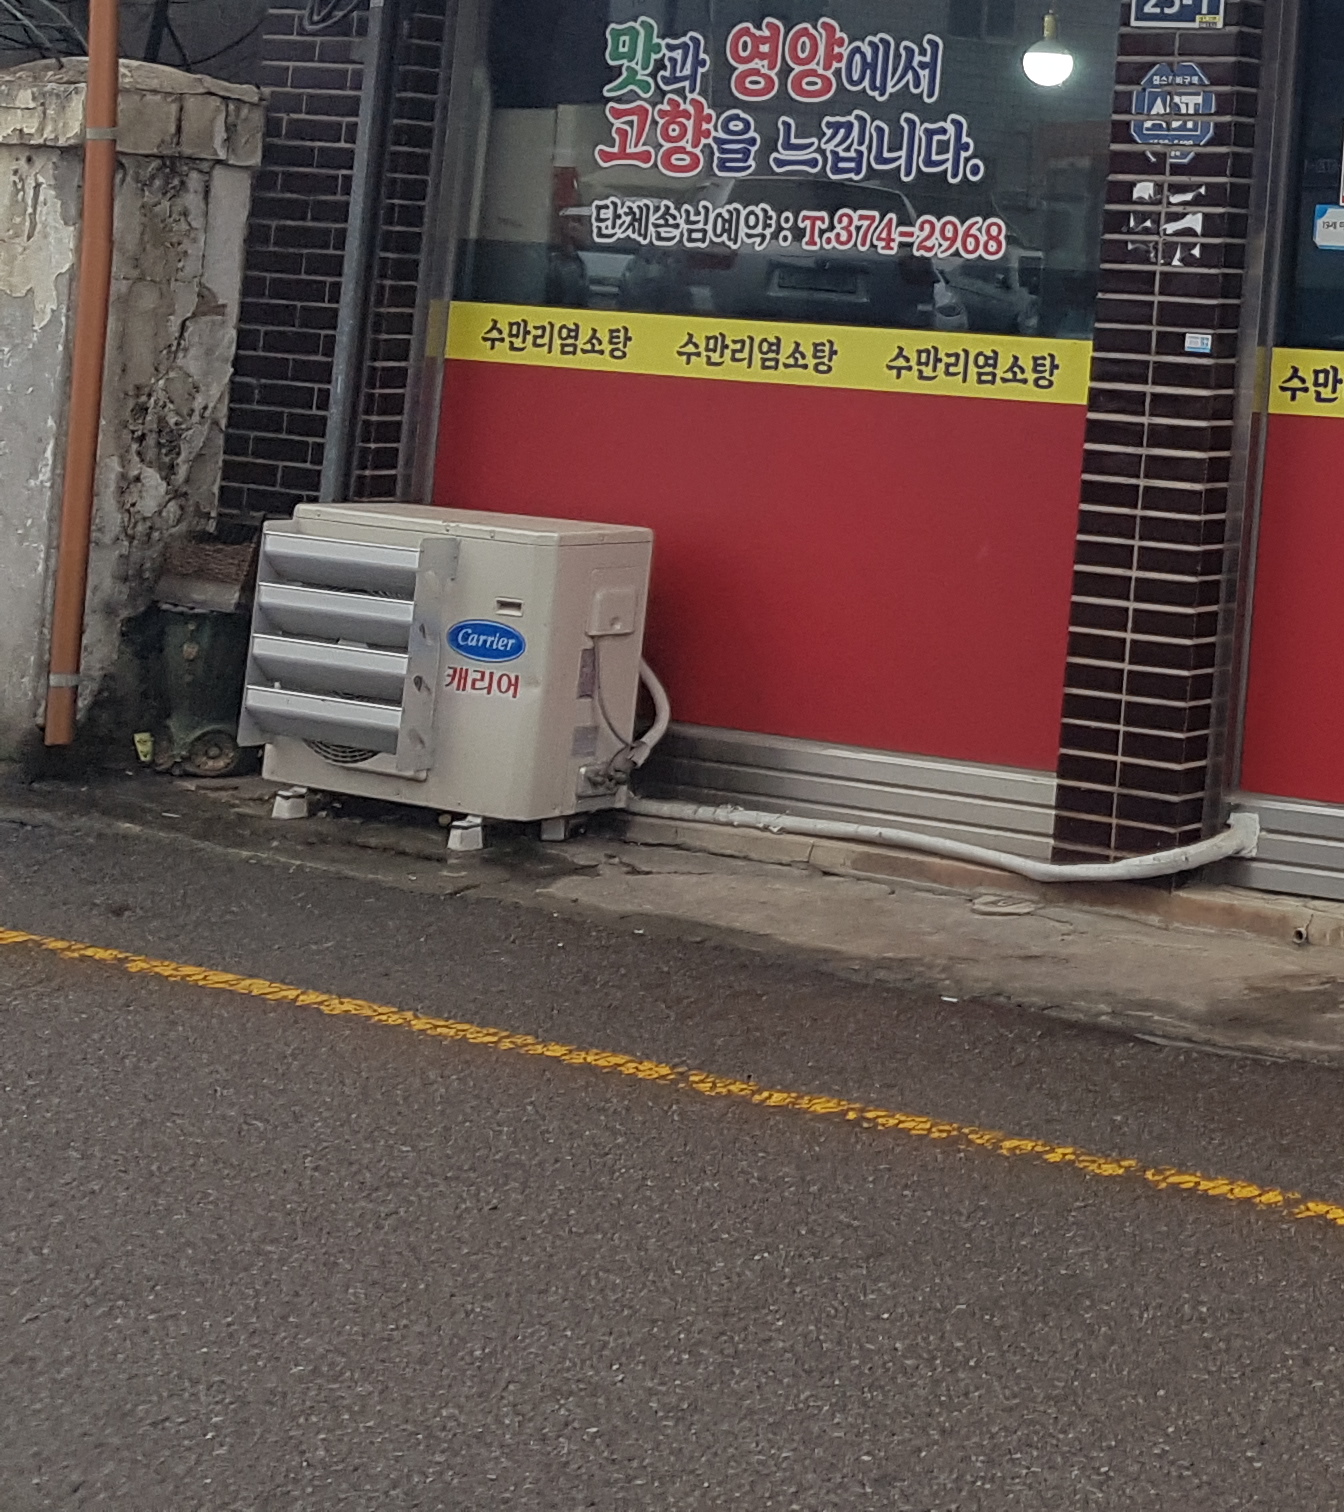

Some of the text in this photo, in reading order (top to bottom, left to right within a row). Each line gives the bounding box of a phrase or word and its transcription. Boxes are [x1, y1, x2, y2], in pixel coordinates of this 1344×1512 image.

[604, 16, 943, 103] 맛과 영양에서
[596, 94, 985, 184] 고향을 느낍니다.
[481, 318, 632, 361] 수만리염소탕
[676, 329, 838, 376] 수만리염소탕
[885, 343, 1061, 391] 수만리염소탕
[457, 627, 516, 651] Carrier
[444, 664, 521, 699] 캐리어
